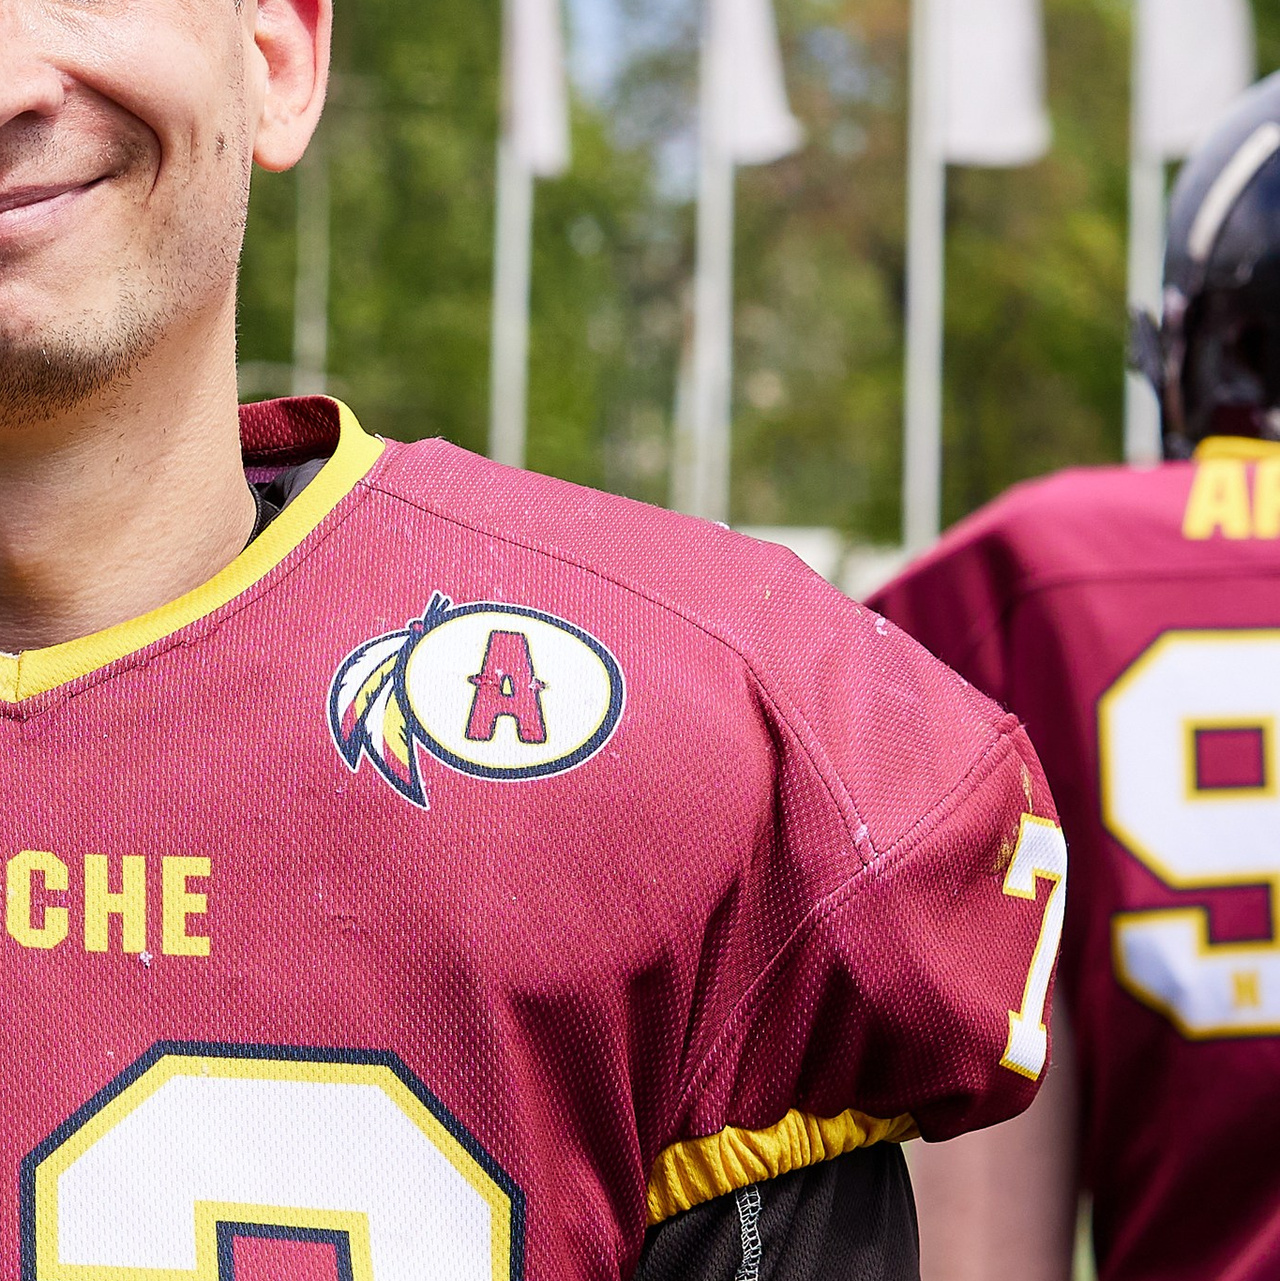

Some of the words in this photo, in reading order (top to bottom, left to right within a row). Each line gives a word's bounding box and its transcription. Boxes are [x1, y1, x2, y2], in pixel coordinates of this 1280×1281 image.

[465, 630, 548, 744] A
[999, 812, 1070, 1082] 7
[1096, 628, 1280, 1042] 9
